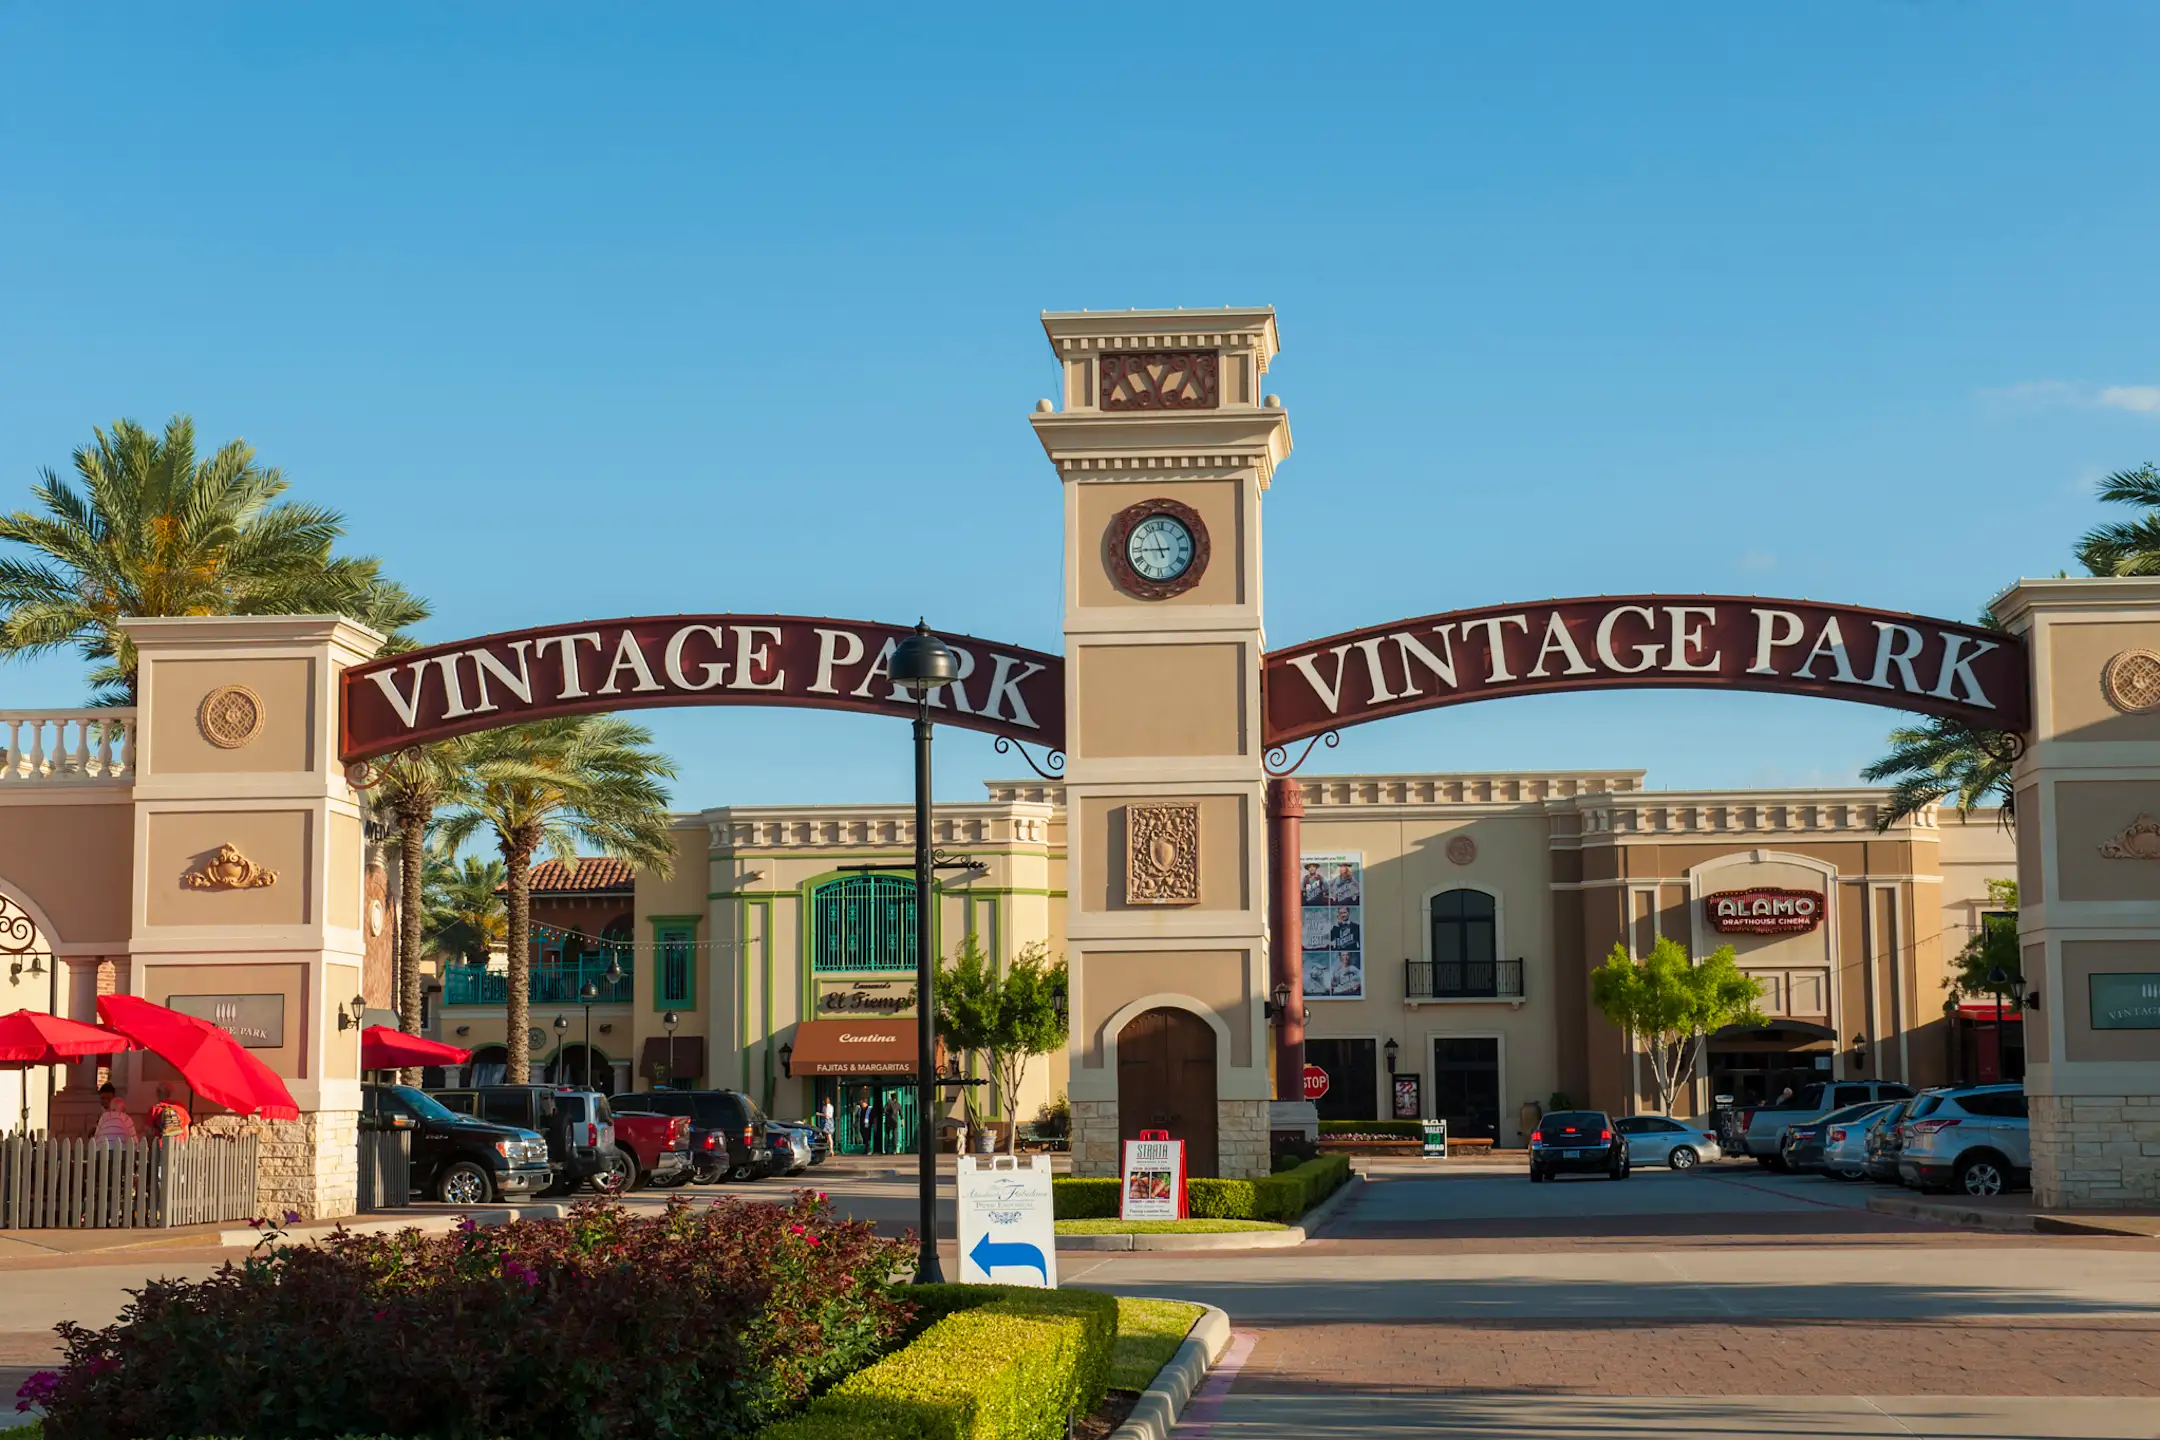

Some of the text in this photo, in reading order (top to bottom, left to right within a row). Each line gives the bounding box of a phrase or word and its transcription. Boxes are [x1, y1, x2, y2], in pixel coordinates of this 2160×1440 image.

[1286, 605, 2000, 714] VINTAGE PARK
[365, 624, 1047, 730] VINTAGE PARK
[1718, 898, 1815, 916] ALAMO
[1723, 918, 1776, 926] DRAFTHOUSE
[826, 992, 846, 1009] El
[2108, 1006, 2160, 1020] VINTAG
[240, 1027, 267, 1039] PARK
[839, 1033, 897, 1043] Cantina
[817, 1063, 909, 1072] FAJITAS & MARGARITAS
[1137, 1144, 1168, 1160] STRATA
